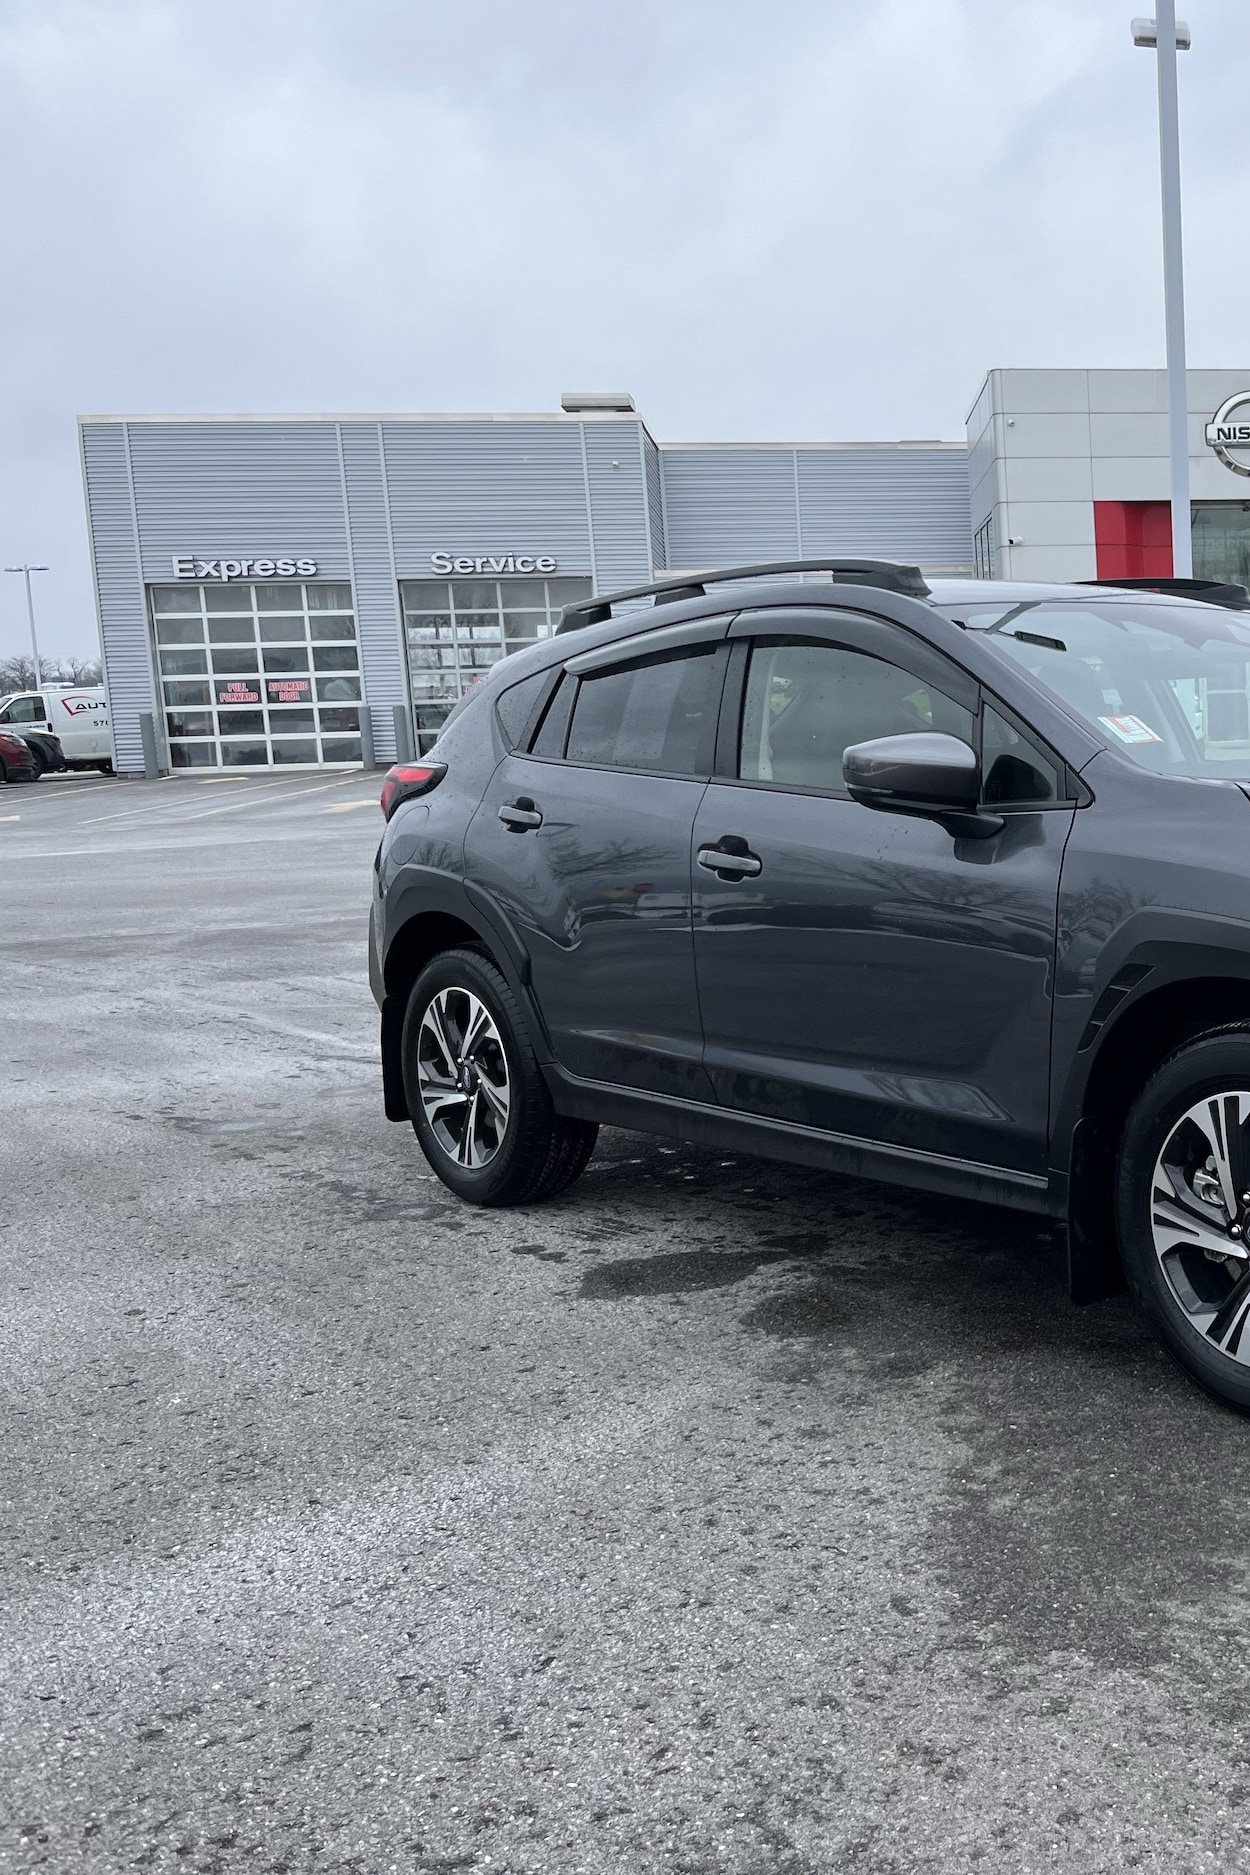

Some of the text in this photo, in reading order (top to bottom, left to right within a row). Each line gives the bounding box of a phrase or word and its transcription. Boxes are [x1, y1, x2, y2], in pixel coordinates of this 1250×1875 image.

[430, 551, 557, 575] Service
[171, 555, 318, 582] Express
[227, 682, 249, 692] PULL
[268, 681, 309, 692] AUTOMATIC
[219, 692, 259, 702] FORWARD
[279, 691, 300, 701] DOOR
